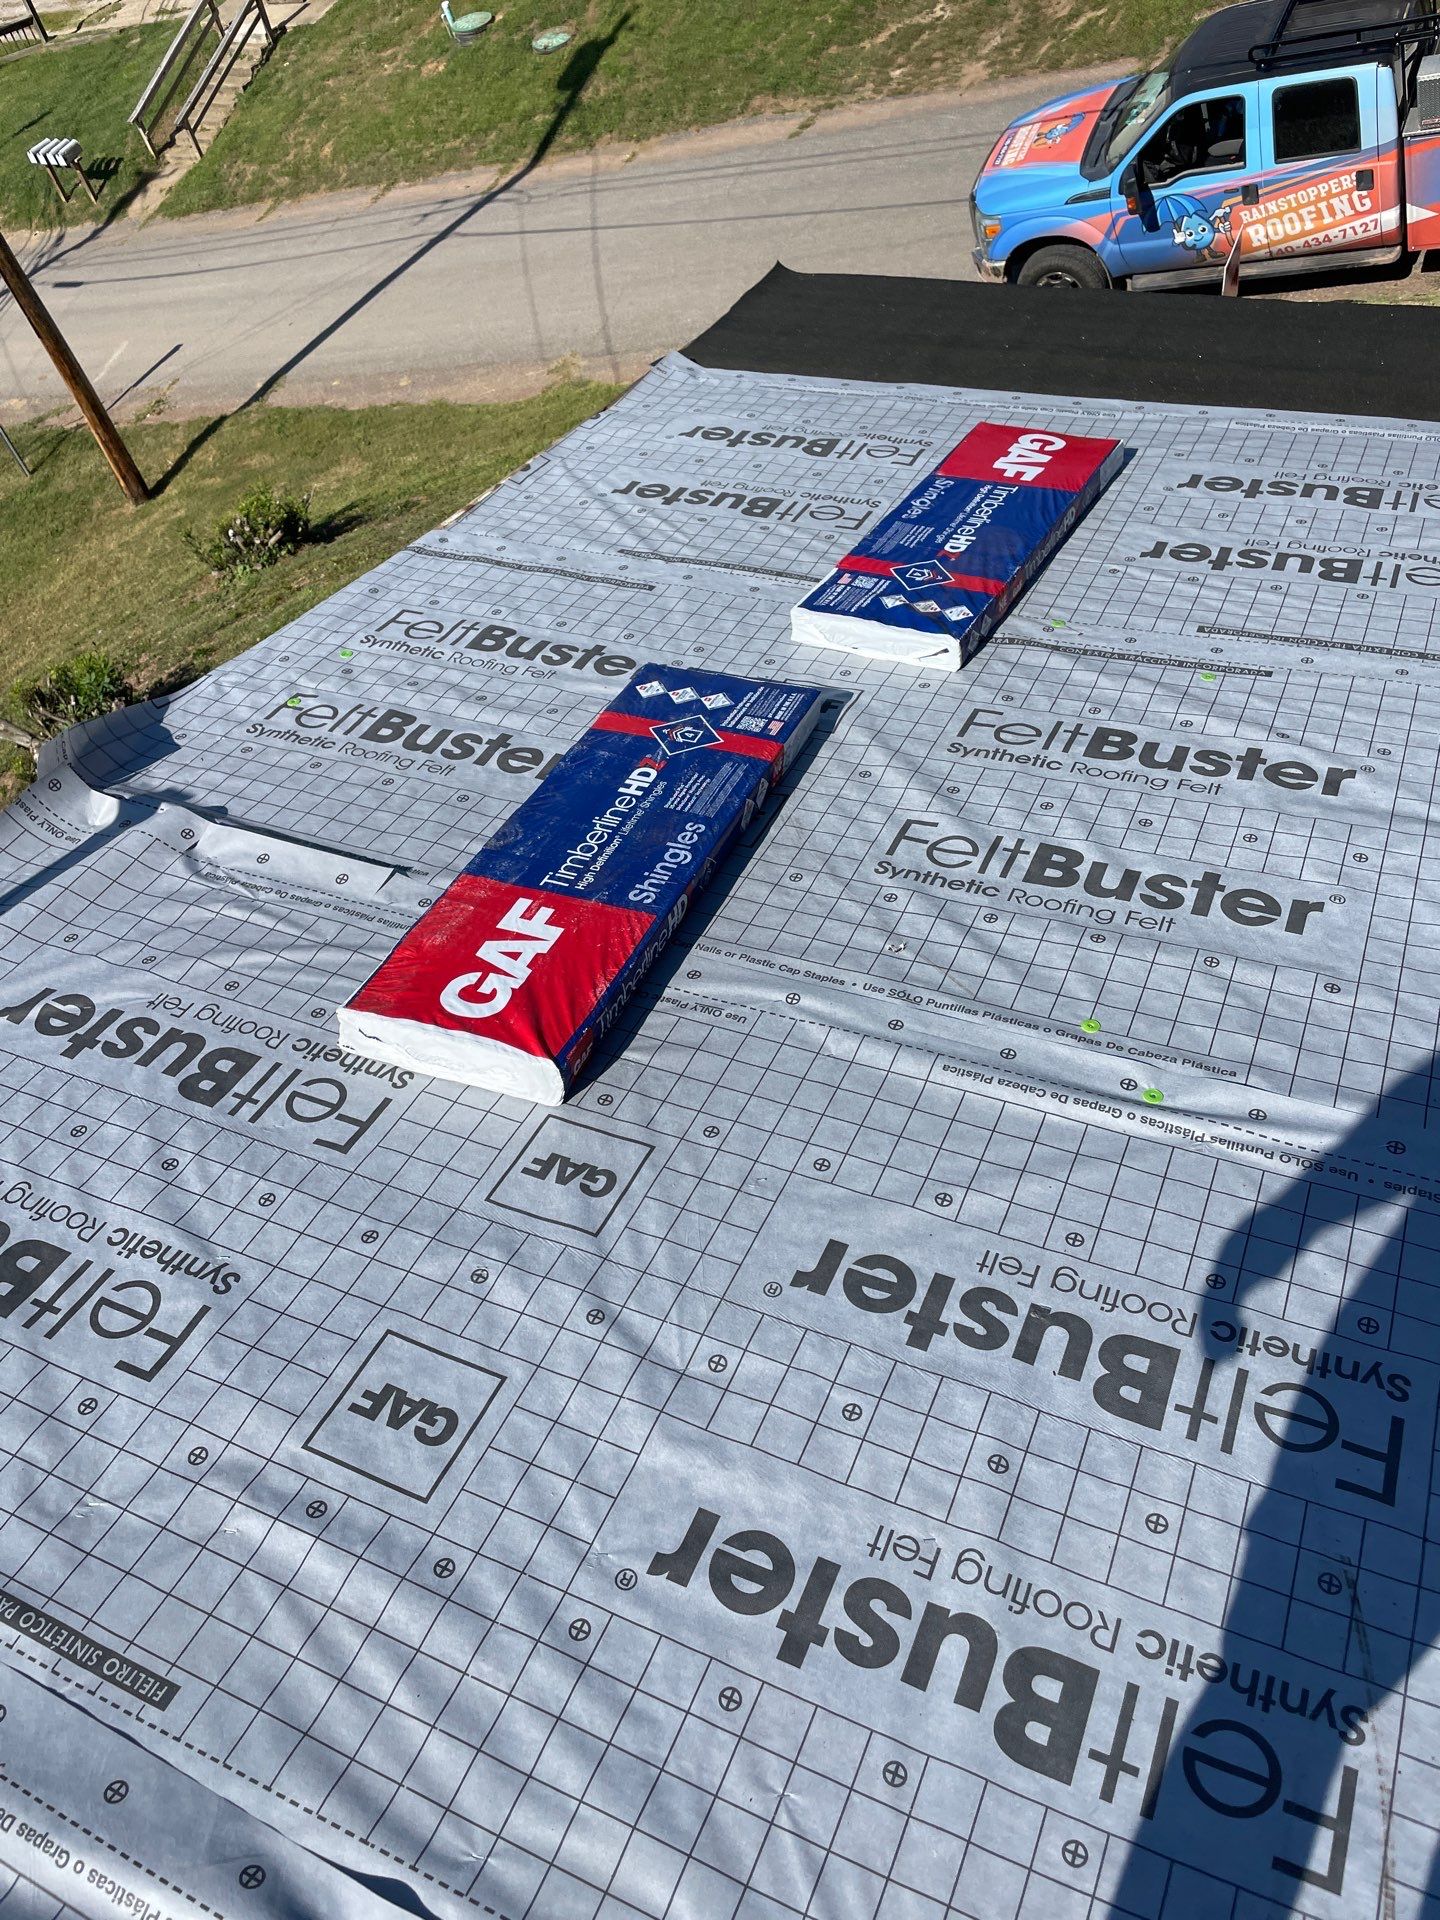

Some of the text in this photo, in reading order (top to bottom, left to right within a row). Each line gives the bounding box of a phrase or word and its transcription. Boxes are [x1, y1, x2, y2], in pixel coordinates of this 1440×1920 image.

[1246, 190, 1372, 247] ROOFING
[678, 425, 925, 466] FeltBuster
[857, 432, 934, 447] Synthetic
[993, 433, 1067, 482] GAF
[700, 479, 881, 508] Synthetic Roofing Felt
[1273, 471, 1306, 480] Felt
[1313, 473, 1391, 487] Roofing
[611, 480, 873, 531] FeltBuster
[1243, 538, 1280, 550] Felt
[1287, 540, 1371, 558] Roofing
[360, 634, 557, 680] Synthetic Roofing Felt
[374, 609, 637, 677] FeltBuste
[246, 723, 455, 777] Synthetic Roofing Felt
[947, 742, 1223, 796] Synthetic Roofing Felt
[956, 708, 1356, 796] FeltBuster
[575, 872, 596, 890] High
[628, 821, 706, 904] Shingles
[885, 819, 1325, 935] FeltBuster
[874, 860, 1176, 933] Synthetic Roofing Felt
[377, 917, 411, 931] untillas
[439, 897, 565, 1018] GAF
[691, 1002, 725, 1017] ONLY
[695, 943, 722, 956] Nails
[724, 950, 737, 958] or
[739, 953, 776, 969] Plastic
[778, 961, 801, 977] Cap
[803, 970, 845, 987] Staples
[862, 982, 886, 995] Use
[926, 998, 979, 1017] Puntillas
[1043, 1025, 1052, 1033] o
[1055, 1029, 1102, 1047] Grapas
[1106, 1040, 1124, 1052] De
[1127, 1046, 1178, 1064] Cabeza
[1181, 1057, 1237, 1078] Plástica
[724, 1012, 748, 1024] Use
[145, 992, 415, 1090] Synthetic Roofing Felt
[0, 987, 393, 1155] FeltBuster
[942, 1064, 994, 1086] Plástica
[997, 1078, 1048, 1099] Cabeza
[1050, 1092, 1068, 1104] De
[1072, 1097, 1123, 1119] Grapas
[1127, 1111, 1136, 1121] o
[1210, 1135, 1275, 1160] Puntillas
[521, 1152, 618, 1198] GAF
[1329, 1166, 1358, 1182] Use
[0, 1181, 241, 1295] Synthetic Roofing
[0, 1221, 212, 1383] FeltB
[975, 1248, 1413, 1404] Synthetic Roofing Felt
[789, 1238, 1406, 1507] FeltBuster
[347, 1383, 460, 1447] GAF
[0, 1597, 168, 1702] FIELTRO SINTÉTICO PA
[867, 1523, 1370, 1747] Synthetic Roofing Felt
[647, 1507, 1359, 1896] FeltBuster
[16, 1822, 70, 1869] Grapas
[73, 1859, 85, 1875] o
